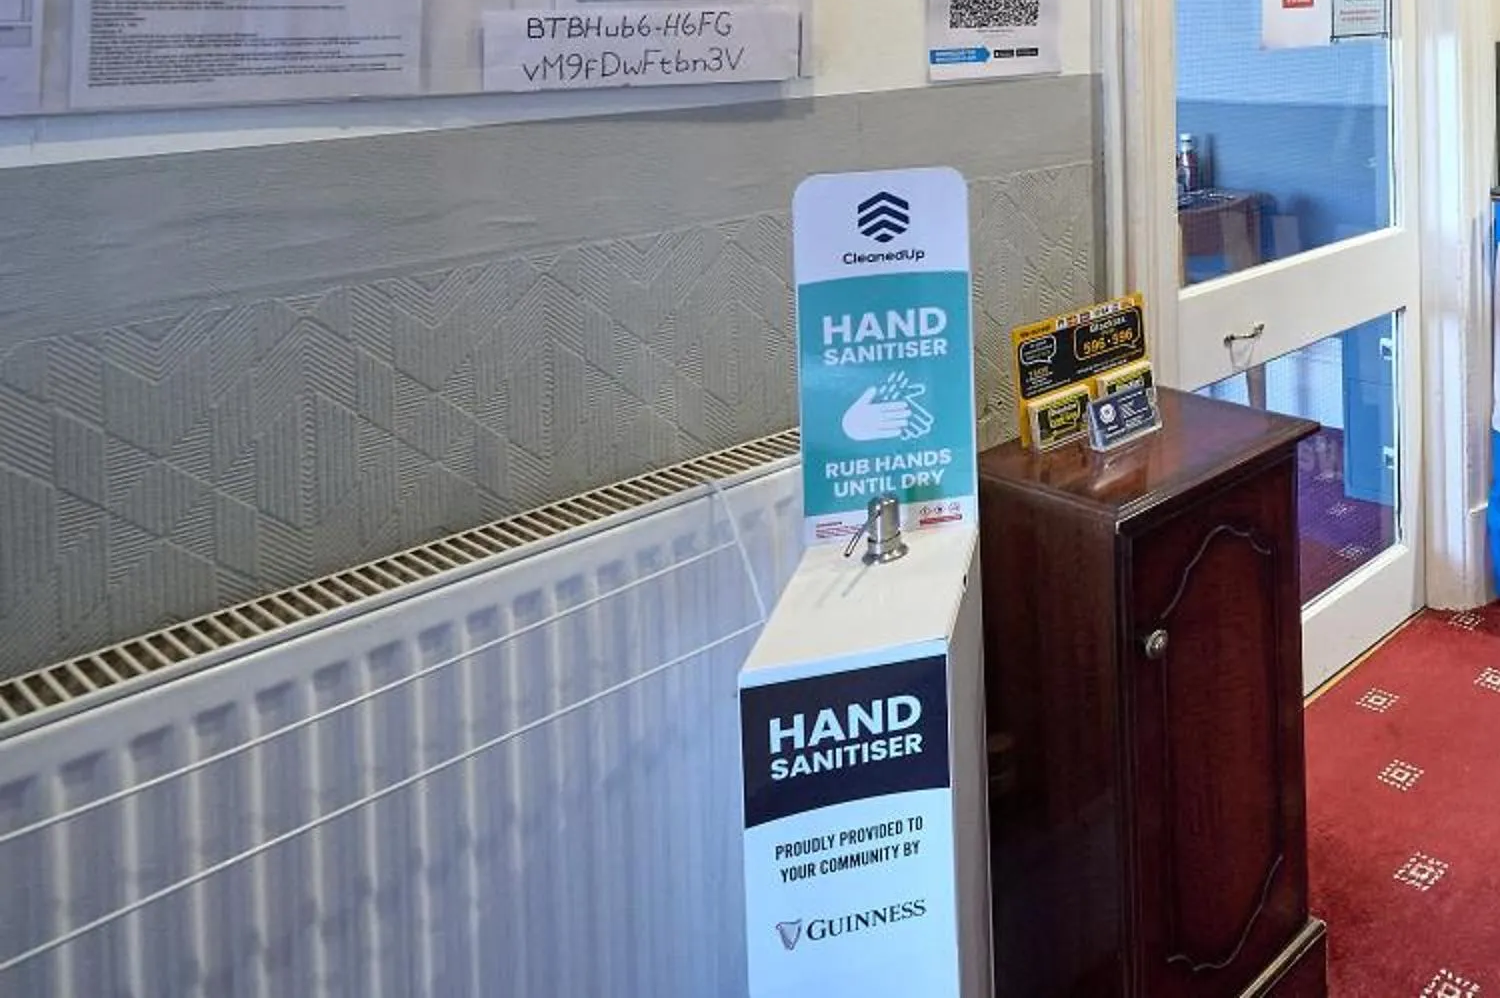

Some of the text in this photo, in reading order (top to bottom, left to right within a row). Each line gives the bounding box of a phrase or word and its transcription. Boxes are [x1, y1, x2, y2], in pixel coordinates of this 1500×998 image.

[842, 248, 925, 266] CleanedUp
[823, 306, 948, 345] HAND
[823, 338, 948, 367] SANITISER
[825, 448, 953, 479] RUB HANDS
[834, 469, 945, 498] UNTIL DRY
[769, 694, 923, 754] HAND
[770, 733, 924, 781] SANITISER
[775, 815, 924, 862] PROUDLY PROVIDED TO
[780, 840, 921, 883] YOUR COMMUNITY BY
[806, 899, 927, 942] GUINNESS
